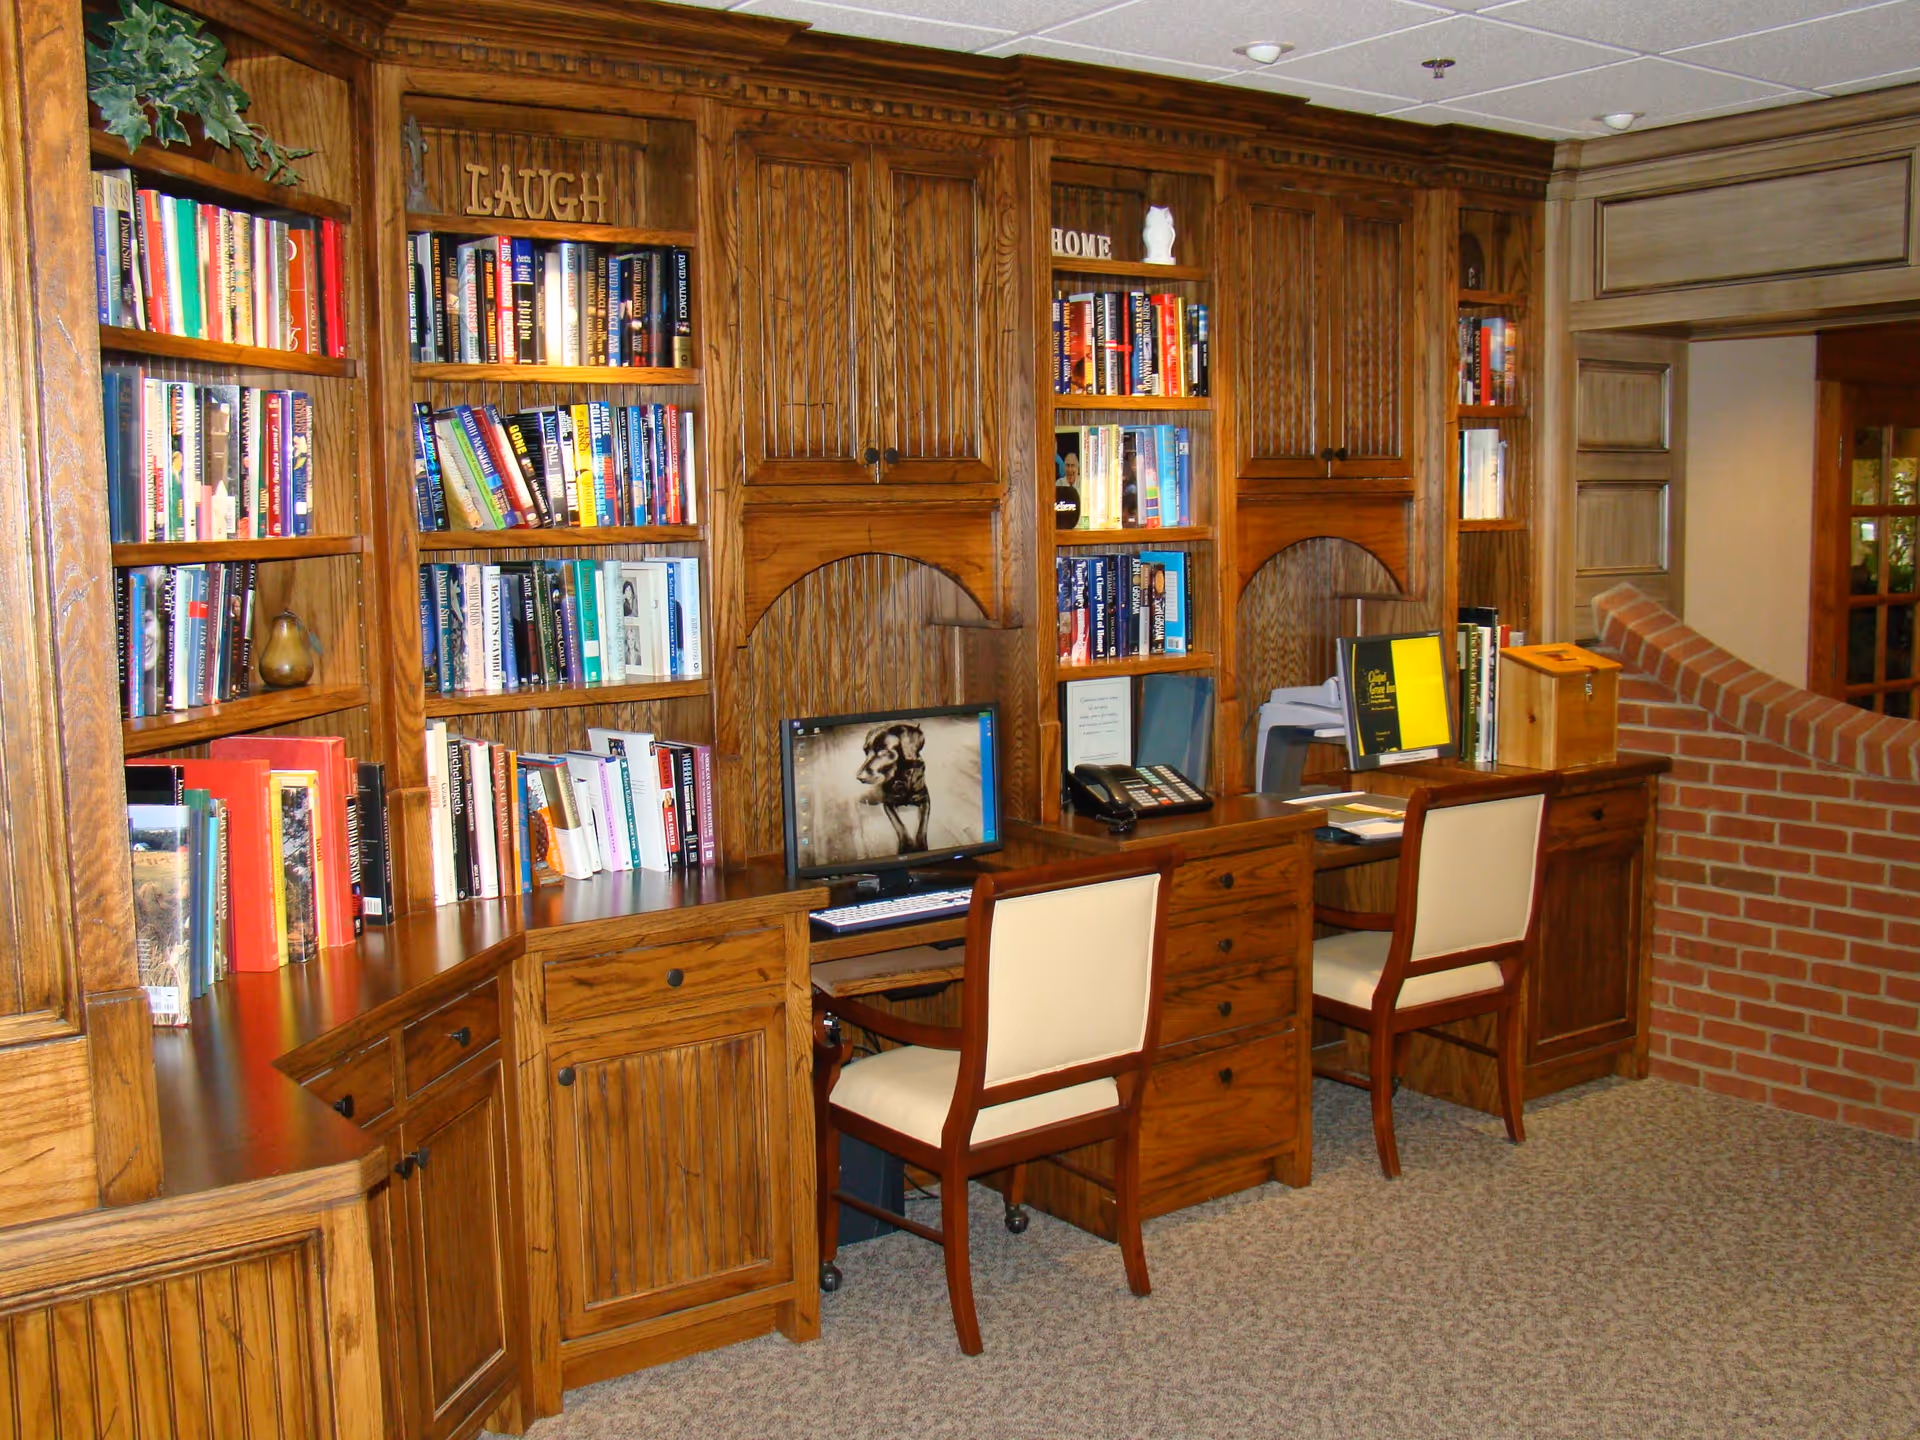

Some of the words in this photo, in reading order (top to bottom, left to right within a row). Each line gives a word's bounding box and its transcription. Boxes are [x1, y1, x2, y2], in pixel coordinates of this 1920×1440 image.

[465, 162, 608, 223] LAUGH
[501, 244, 512, 262] IRIS
[1051, 227, 1112, 260] HOME
[568, 248, 576, 270] DAVID
[598, 258, 606, 276] DAVID
[633, 260, 642, 282] DAVID
[678, 254, 686, 279] DAVID
[502, 263, 513, 308] JOHANSEN
[588, 271, 596, 305] BALDACCI
[608, 262, 618, 287] DAVID
[467, 278, 478, 334] JOHANSEN
[598, 278, 606, 308] BALDACCI
[633, 284, 642, 318] BALDACCI
[680, 280, 688, 318] BALDACCI
[608, 290, 619, 330] BALDACCI
[488, 312, 496, 344] STALEMATE
[502, 311, 514, 358] QUICKSAND
[1143, 360, 1152, 391] PARANOIA
[462, 411, 477, 436] JUDITH
[590, 403, 602, 439] COLLINS
[600, 406, 610, 436] JACKIE
[508, 424, 528, 454] GONE
[531, 480, 540, 490] LISA
[1132, 558, 1140, 574] JOHN
[420, 572, 429, 601] Daniel
[437, 570, 448, 606] DANIELLE
[524, 576, 532, 596] ANNE
[1094, 577, 1103, 602] Clancy
[1132, 586, 1140, 615] GRISHAM
[421, 604, 431, 624] Silva
[440, 608, 450, 628] STEEL
[490, 584, 500, 636] McNALLY'S
[525, 600, 534, 622] PERRY
[1154, 600, 1162, 614] JOHN
[1155, 614, 1164, 641] GRISHAM
[196, 649, 206, 699] RUSSERT
[491, 639, 500, 680] GAMBLE
[451, 745, 463, 815] michelangelo
[497, 752, 508, 791] PALACES
[622, 771, 630, 789] Select
[500, 792, 508, 805] OF
[625, 790, 633, 816] Editions
[347, 804, 357, 829] DAVID
[500, 806, 509, 840] VENICE
[348, 829, 361, 883] HALBERSTAM
